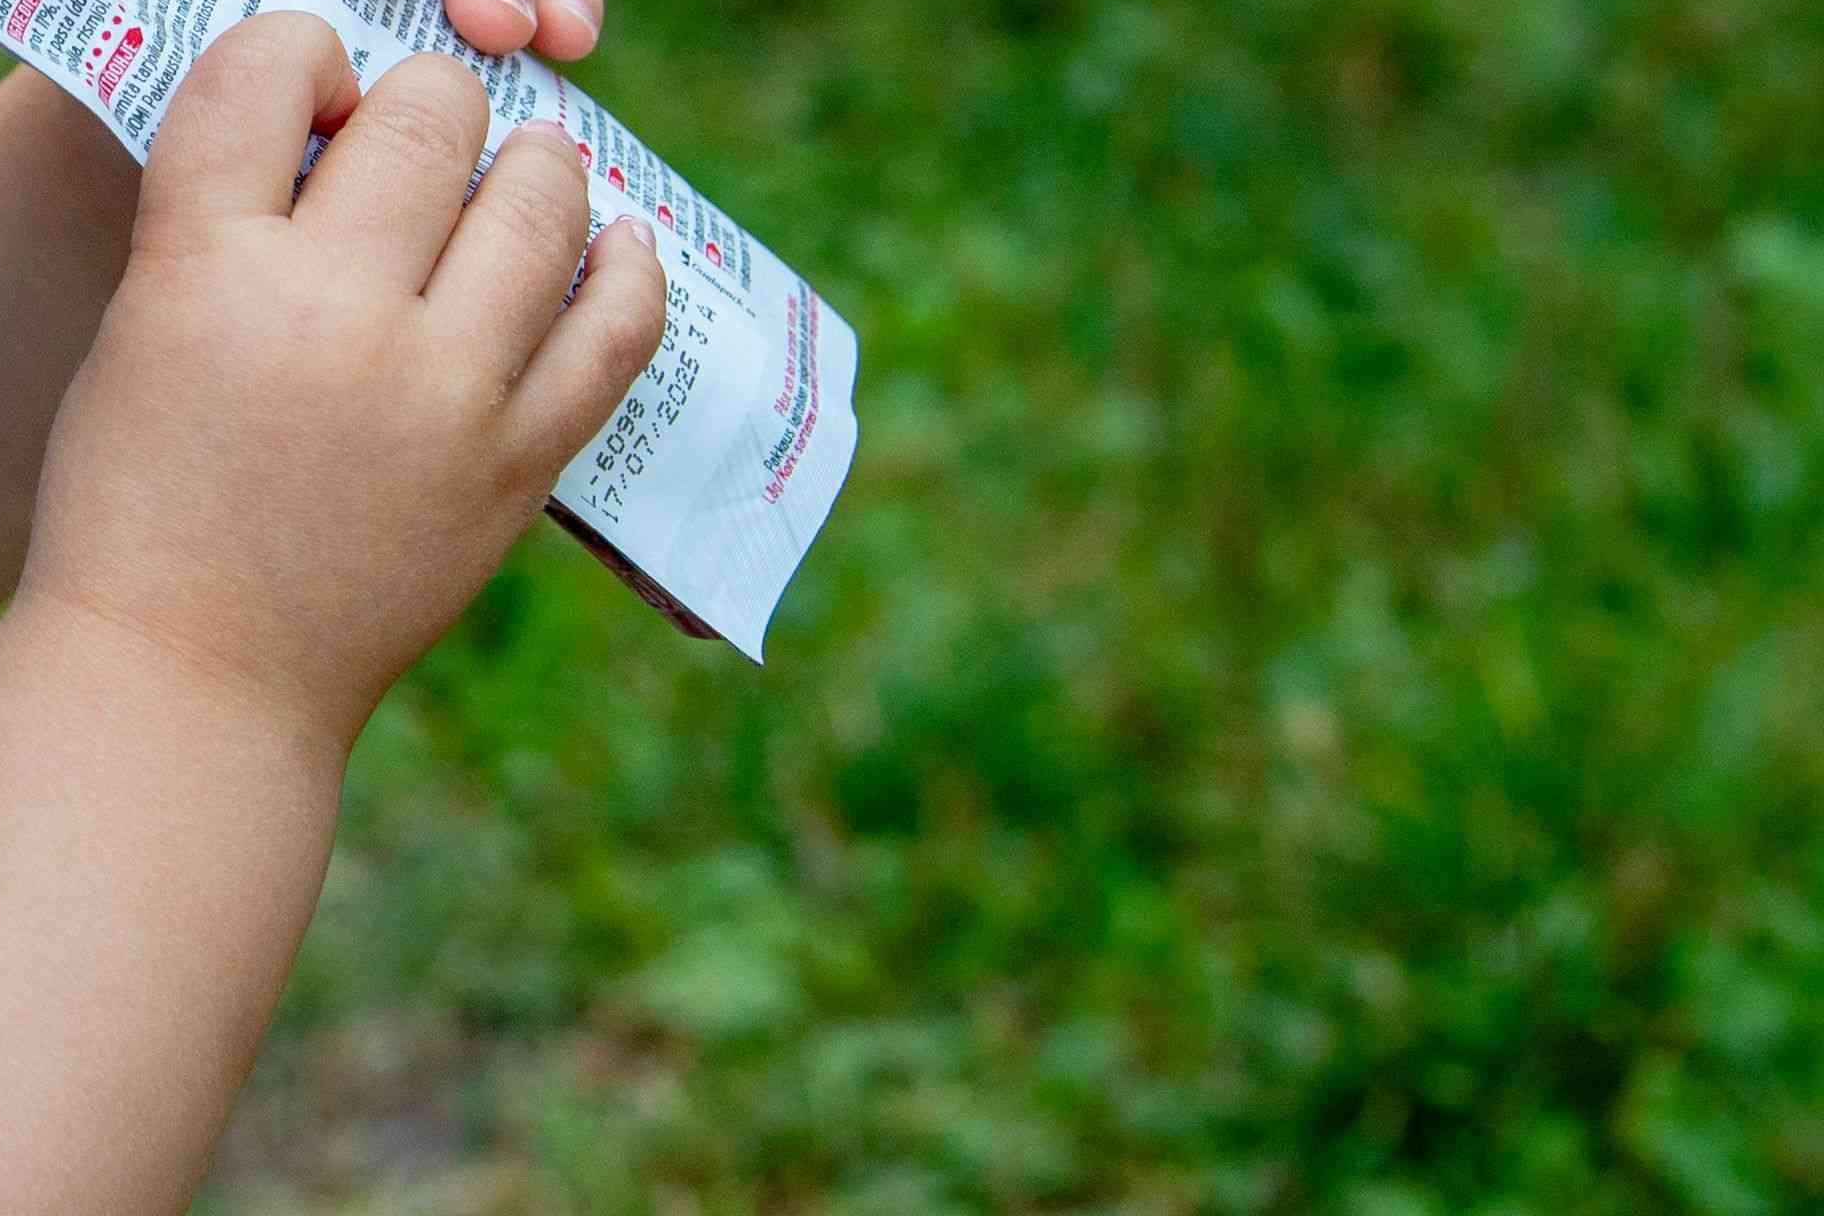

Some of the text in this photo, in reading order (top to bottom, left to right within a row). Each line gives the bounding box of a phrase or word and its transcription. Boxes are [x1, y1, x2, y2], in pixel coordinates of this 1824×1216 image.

[29, 28, 45, 53] rot
[51, 16, 75, 53] pasta
[125, 105, 152, 139] UOM!
[602, 351, 699, 523] 17/07/2025
